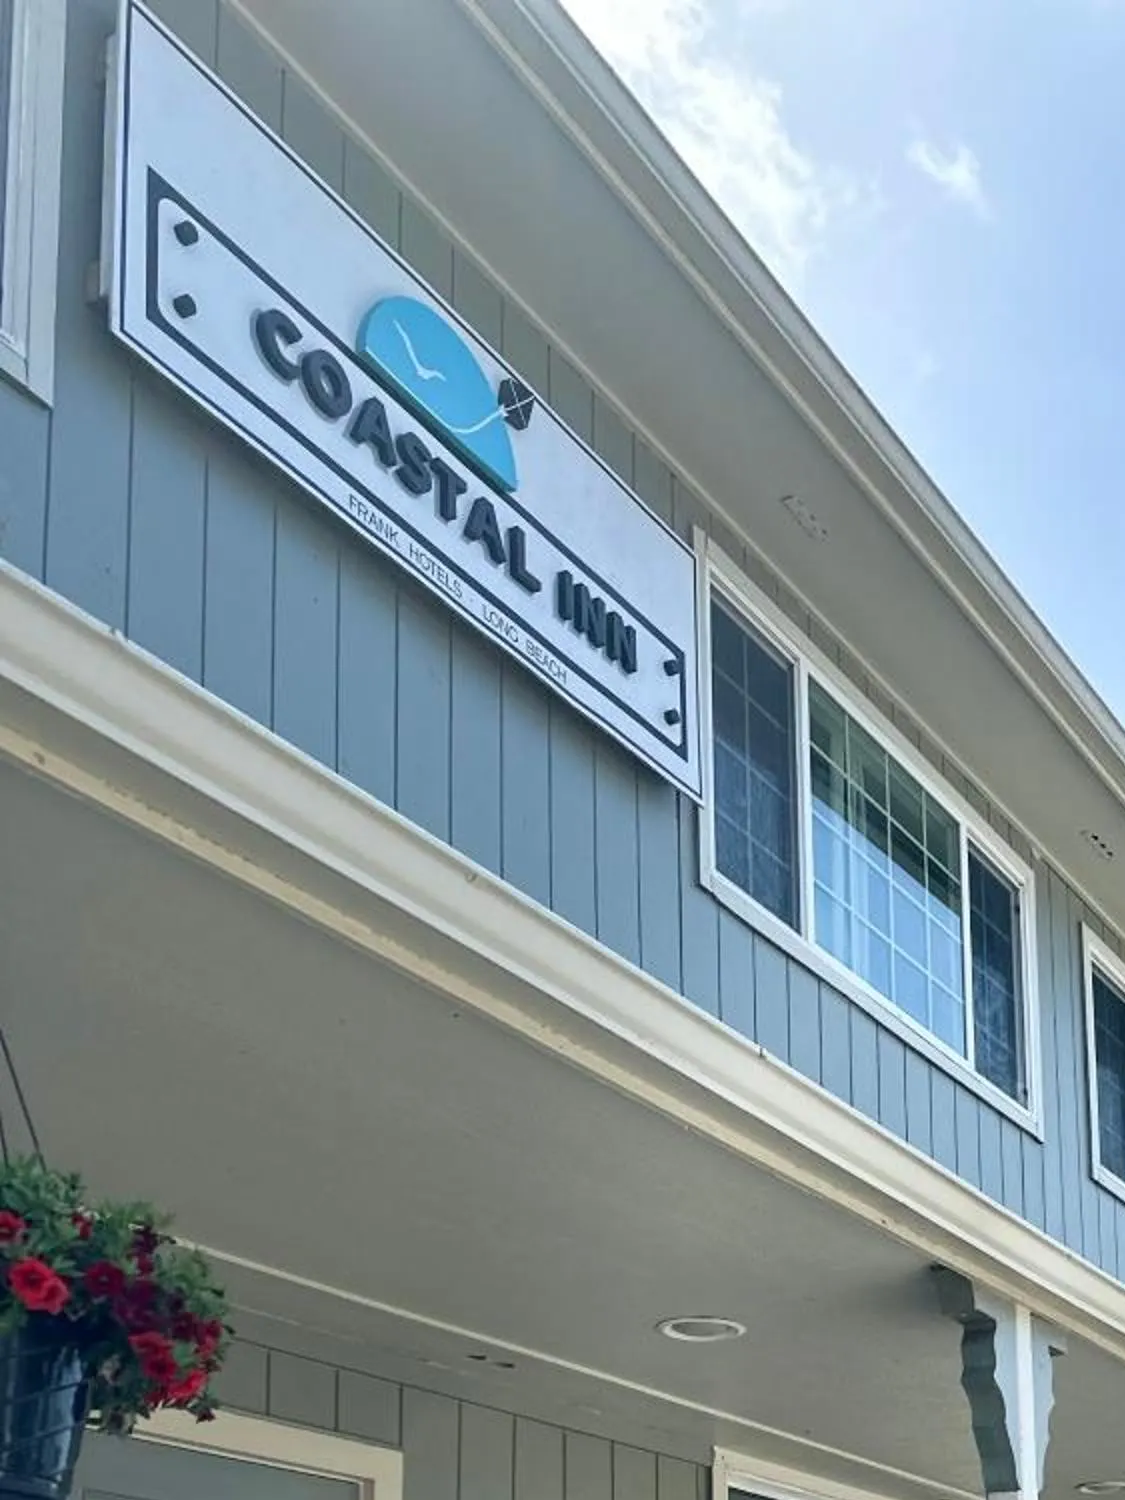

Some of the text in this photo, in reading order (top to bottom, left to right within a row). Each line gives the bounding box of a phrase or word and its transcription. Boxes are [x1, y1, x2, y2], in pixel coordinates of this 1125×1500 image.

[252, 307, 638, 675] COASTAL INN
[349, 494, 568, 684] FRANK HOTELS LONG BEACH
